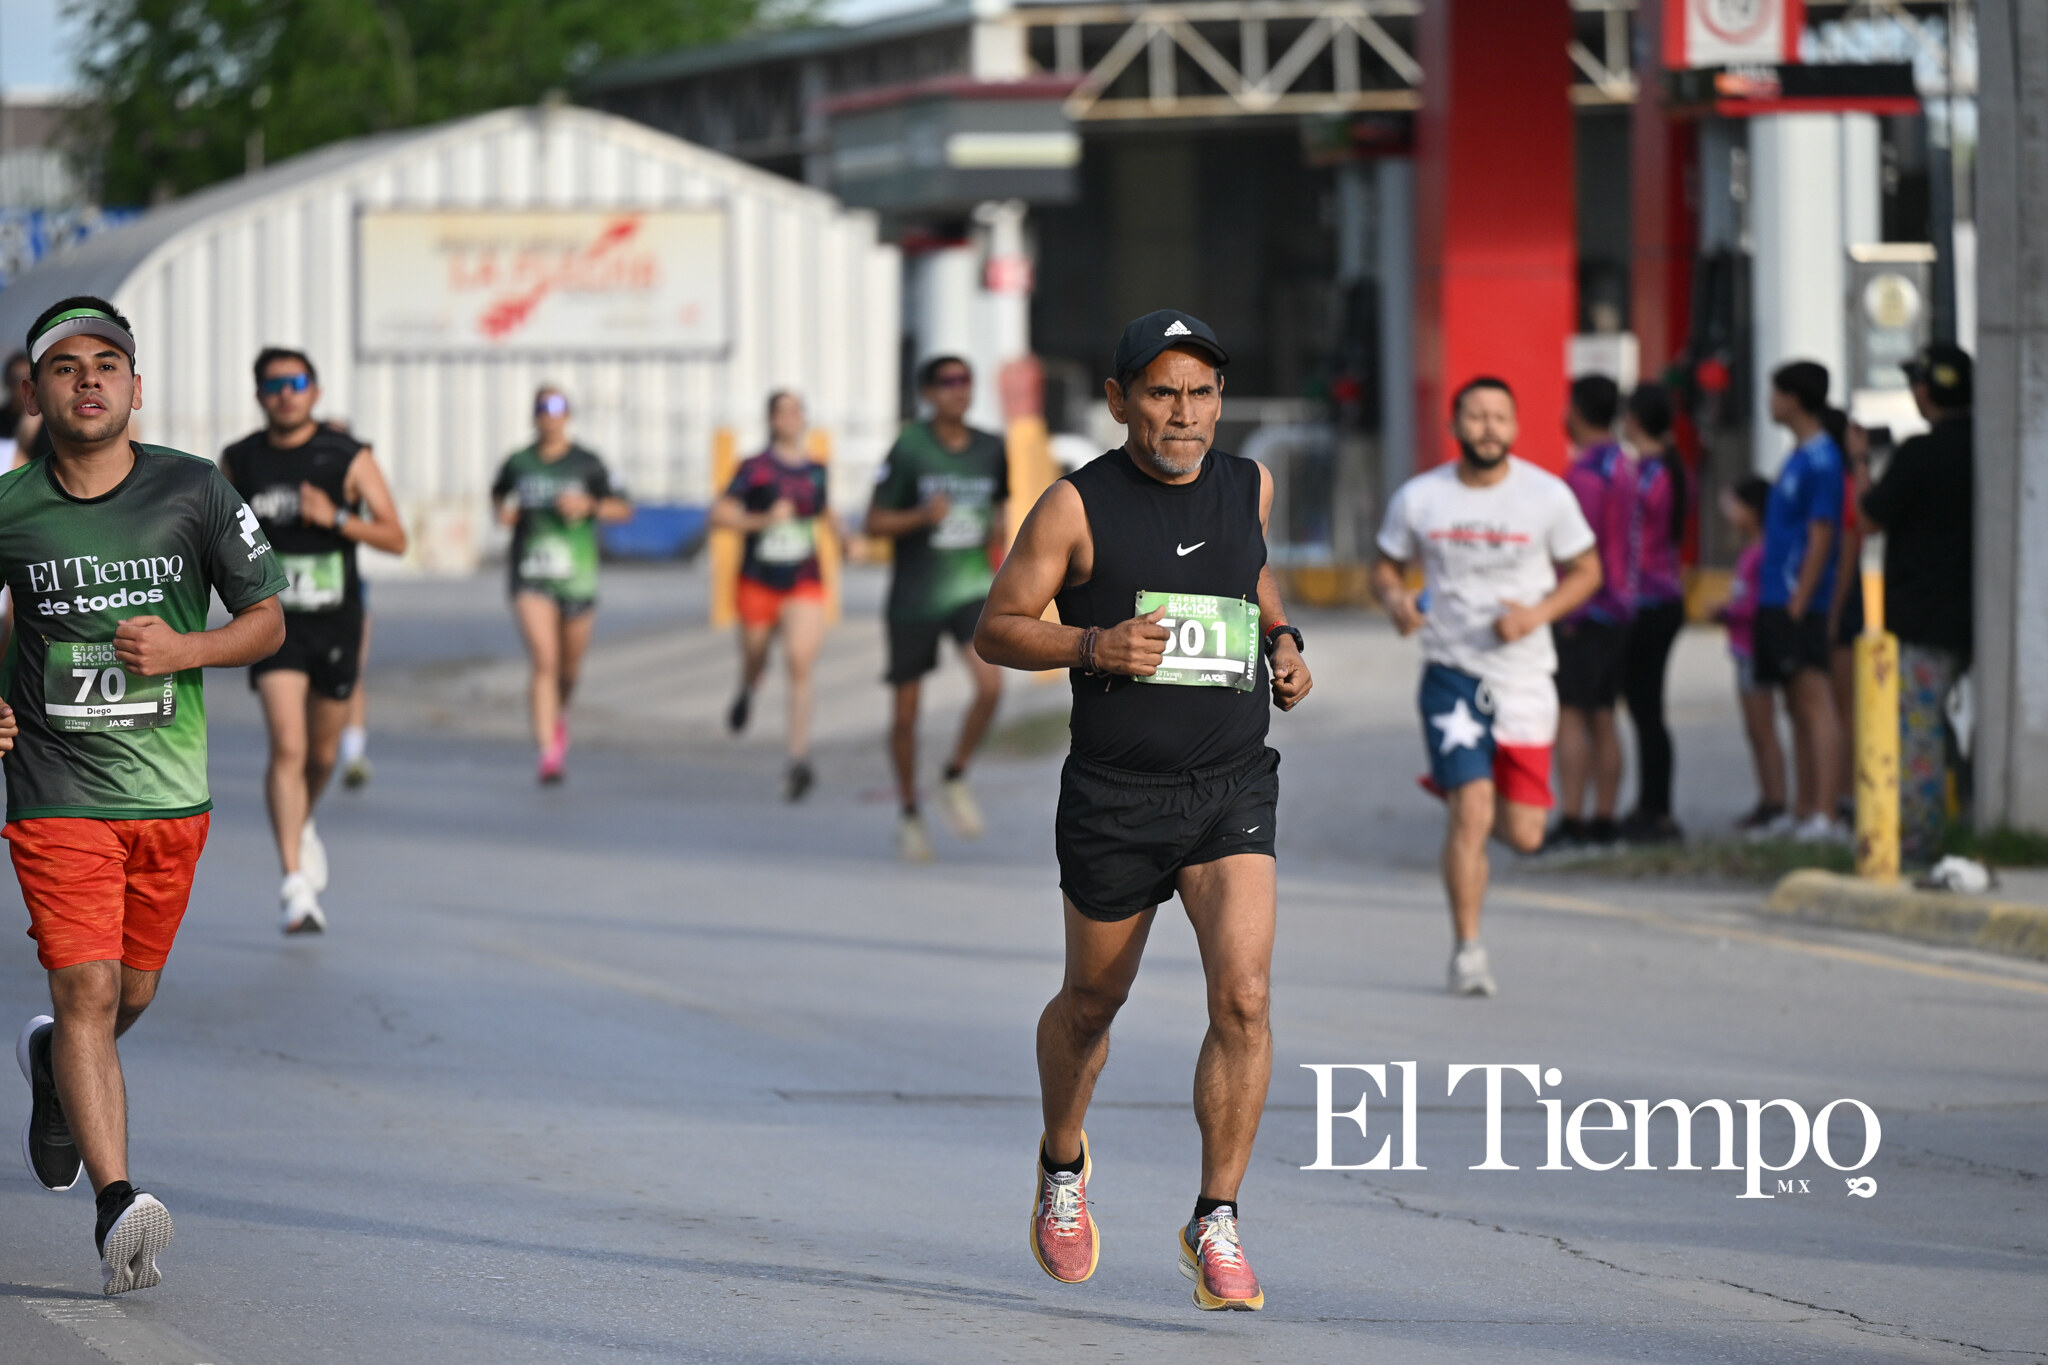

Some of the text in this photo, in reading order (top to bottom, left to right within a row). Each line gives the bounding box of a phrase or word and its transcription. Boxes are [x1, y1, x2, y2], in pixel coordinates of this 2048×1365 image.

[26, 555, 183, 593] El Tiempo
[38, 588, 164, 616] de todos
[1168, 595, 1218, 604] CARRERA
[1156, 619, 1226, 656] 501
[1246, 622, 1256, 680] MEDALLA
[72, 667, 126, 703] 70
[163, 674, 173, 715] MEDAL
